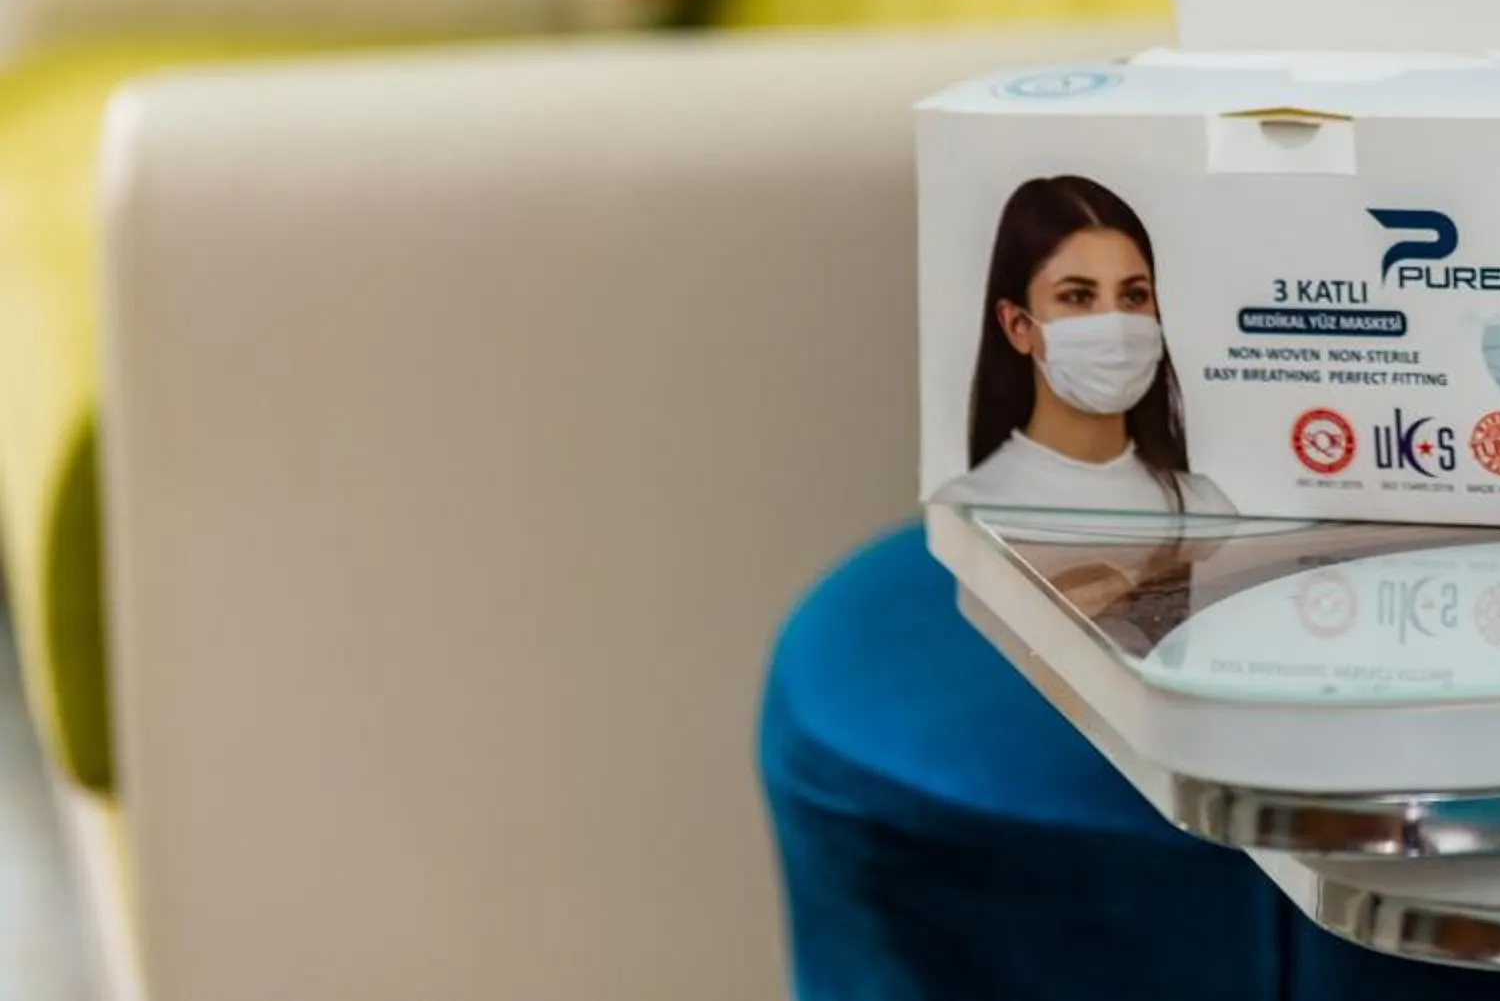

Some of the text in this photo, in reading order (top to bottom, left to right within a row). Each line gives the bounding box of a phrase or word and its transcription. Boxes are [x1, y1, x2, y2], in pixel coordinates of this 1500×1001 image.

[1273, 279, 1368, 304] 3 KATLI
[1243, 312, 1402, 332] MEDİKAL YÜZ MASKESİ
[1228, 346, 1420, 364] NON-WOVEN NON-STERILE
[1204, 367, 1448, 387] EASY BREATHING PERFECT FITTING
